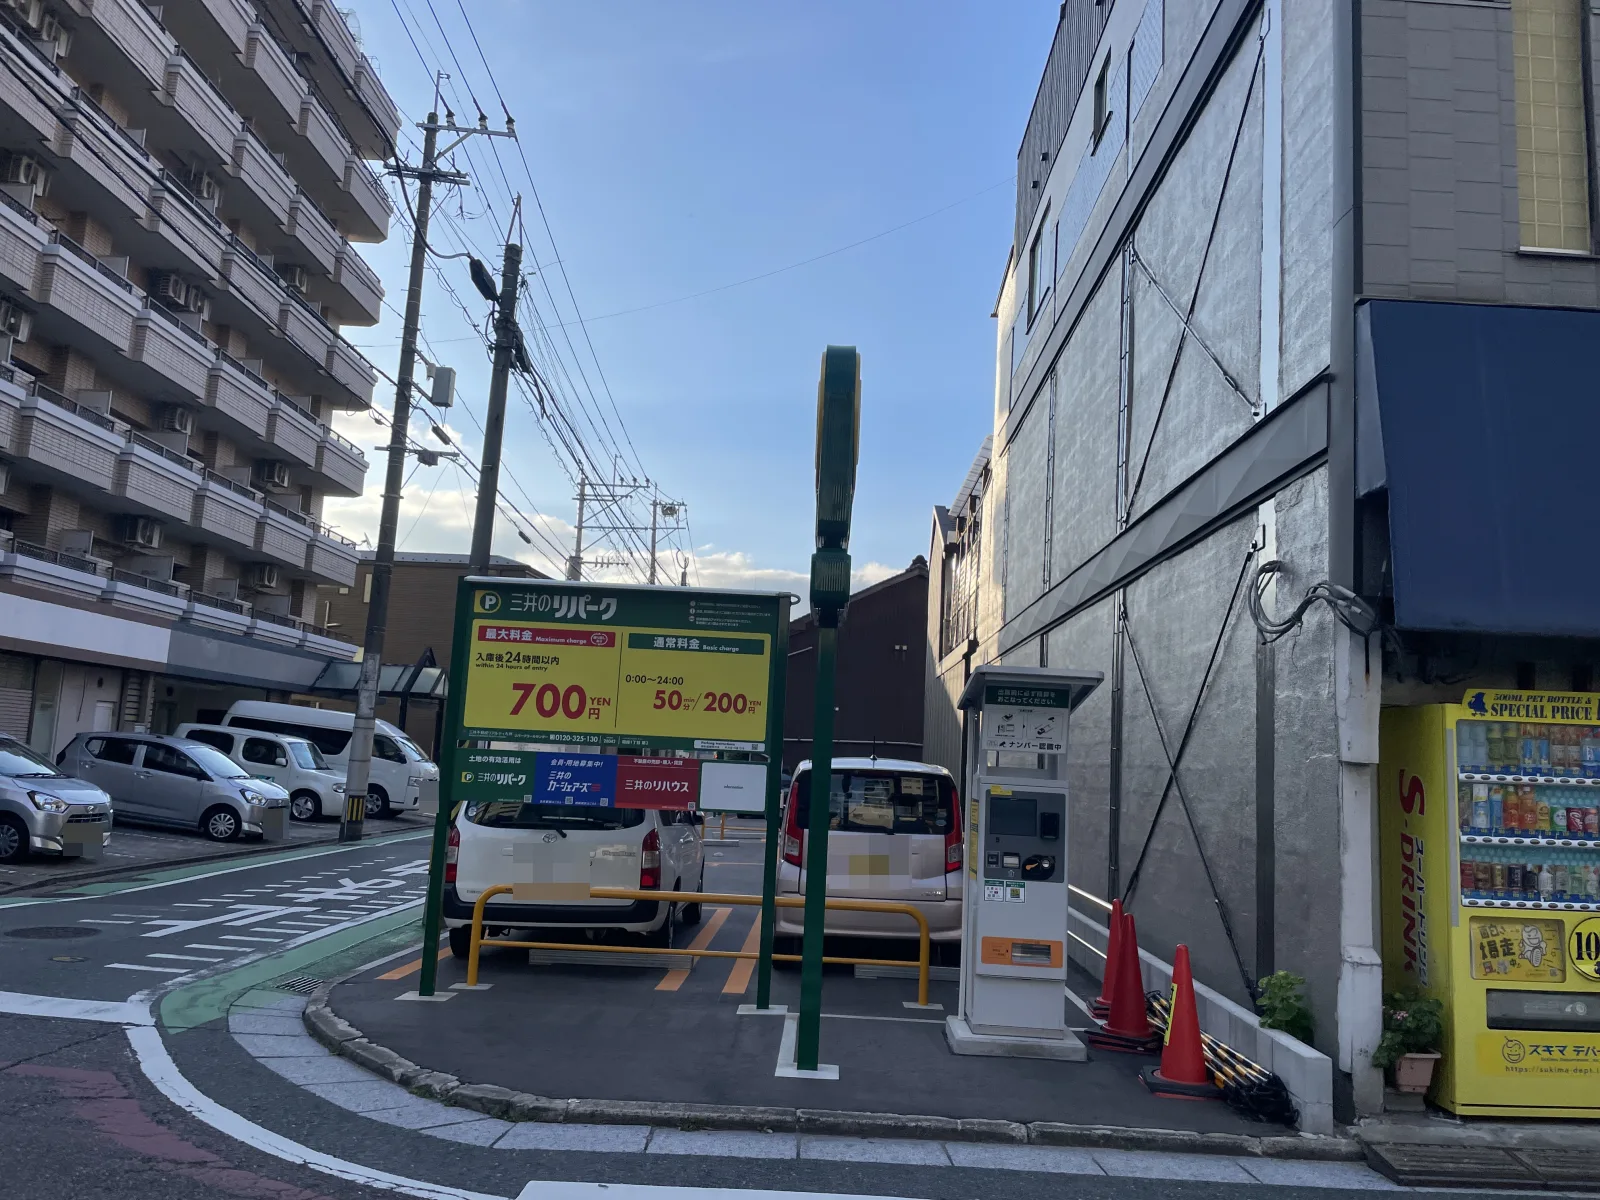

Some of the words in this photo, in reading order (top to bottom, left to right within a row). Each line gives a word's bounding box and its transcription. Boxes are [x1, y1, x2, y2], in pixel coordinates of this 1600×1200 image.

[509, 592, 618, 621] 三井のリパーク
[485, 628, 533, 642] 最大料金
[653, 636, 700, 650] 通常料金
[476, 650, 560, 666] 入庫後24時間以内
[509, 682, 587, 719] 700
[589, 697, 611, 706] YEN
[653, 689, 682, 711] 50
[703, 692, 747, 714] 200
[1493, 694, 1524, 702] 500ML
[1547, 696, 1583, 704] BOTTLE
[588, 708, 600, 720] 円
[1490, 703, 1548, 718] SPECIAL
[1551, 706, 1592, 720] PRICE
[555, 734, 598, 743] 0120-325-130
[468, 755, 522, 764] 土地の有効活用は
[477, 772, 526, 786] 三井のリパーク
[548, 770, 572, 780] 三井の
[547, 780, 592, 792] カーシェアーズ
[624, 779, 689, 793] 三井のリハウス
[1528, 1044, 1568, 1056] スキマ
